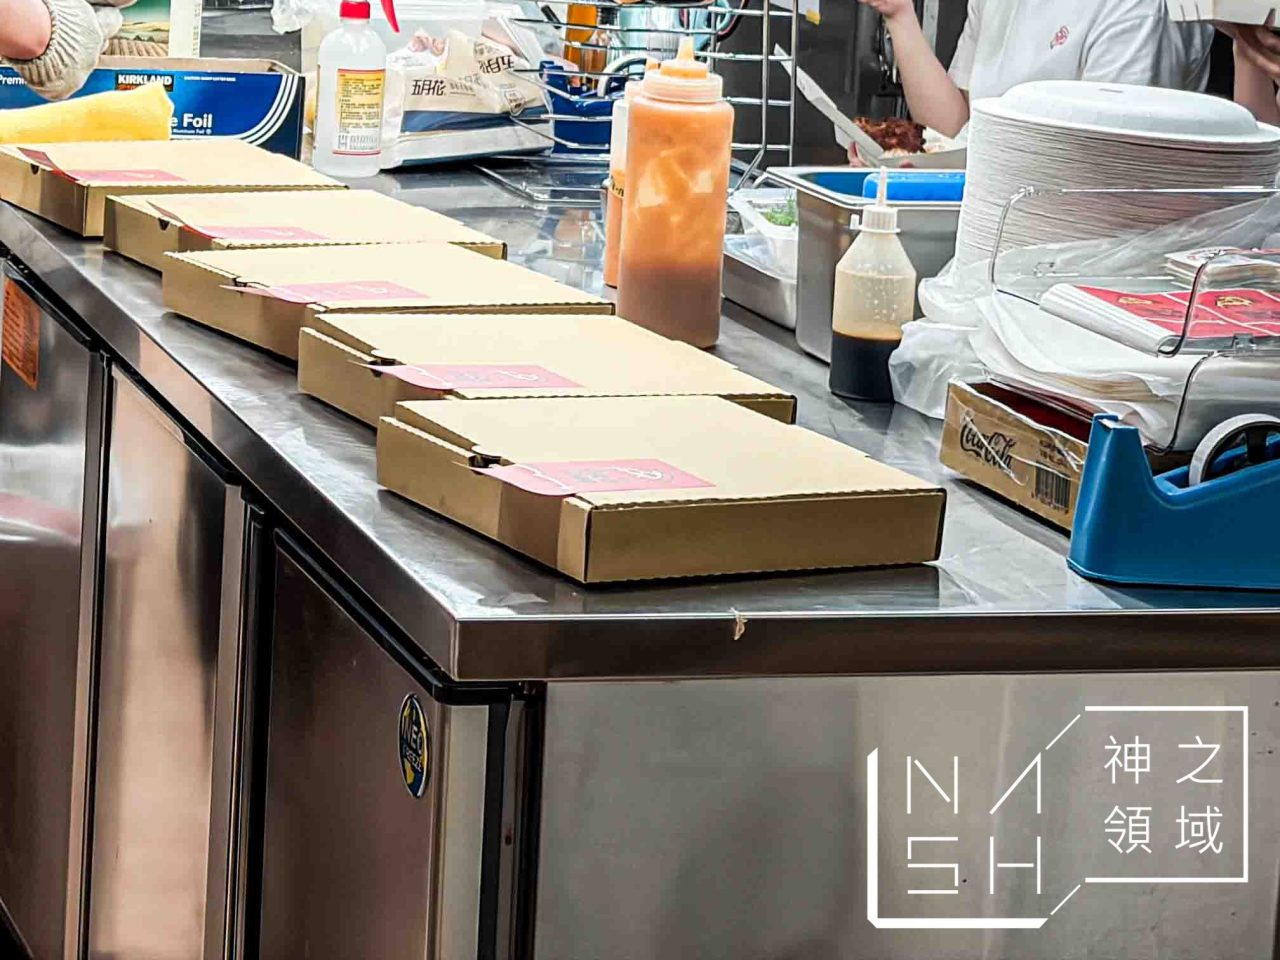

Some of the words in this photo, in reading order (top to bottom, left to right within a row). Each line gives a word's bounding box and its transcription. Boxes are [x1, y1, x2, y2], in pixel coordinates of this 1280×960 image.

[117, 74, 173, 86] KIRKLAND
[411, 79, 447, 96] 五月花
[183, 113, 213, 128] Foil
